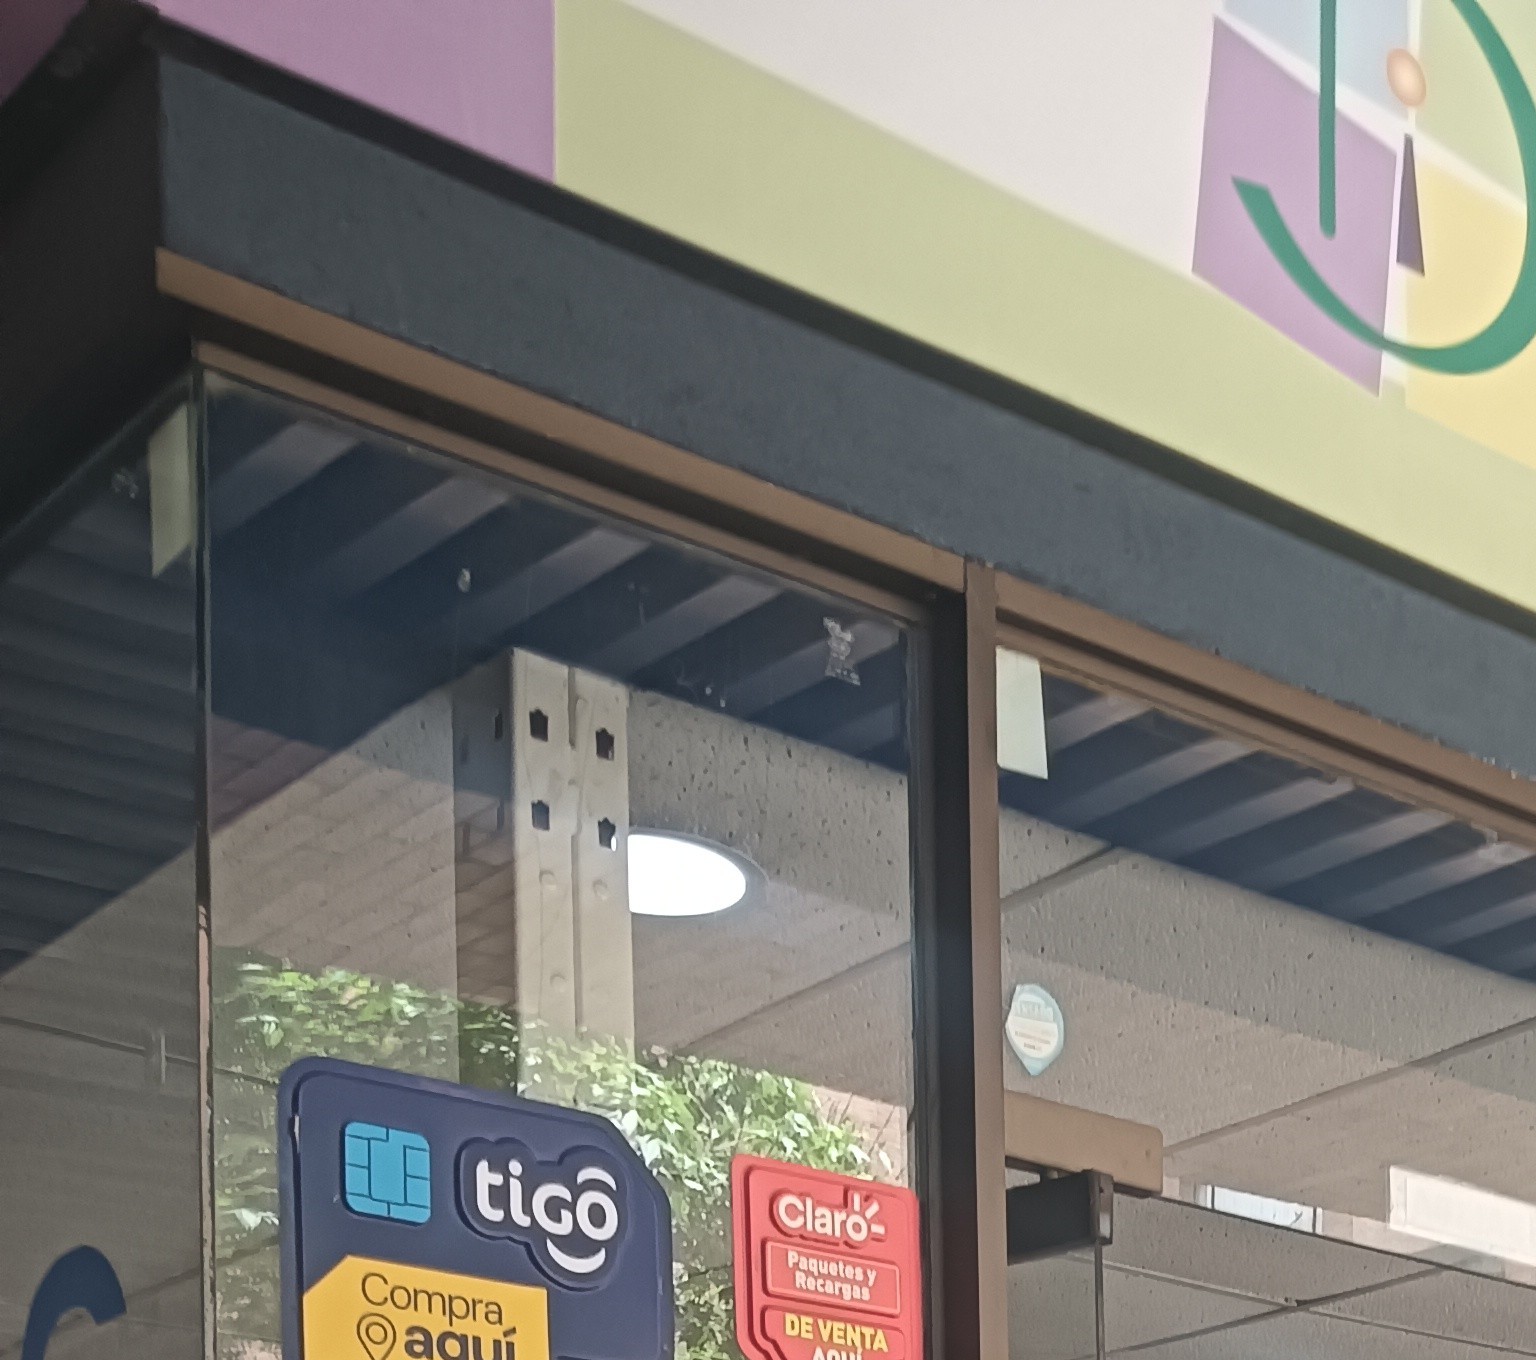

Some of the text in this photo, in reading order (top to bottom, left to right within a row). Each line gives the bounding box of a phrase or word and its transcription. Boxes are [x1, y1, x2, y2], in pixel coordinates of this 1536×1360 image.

[778, 1193, 884, 1242] Claro
[787, 1250, 877, 1287] Paquetes y
[795, 1270, 871, 1301] Recargas
[360, 1272, 503, 1327] Compra
[784, 1312, 889, 1353] DE VENTA
